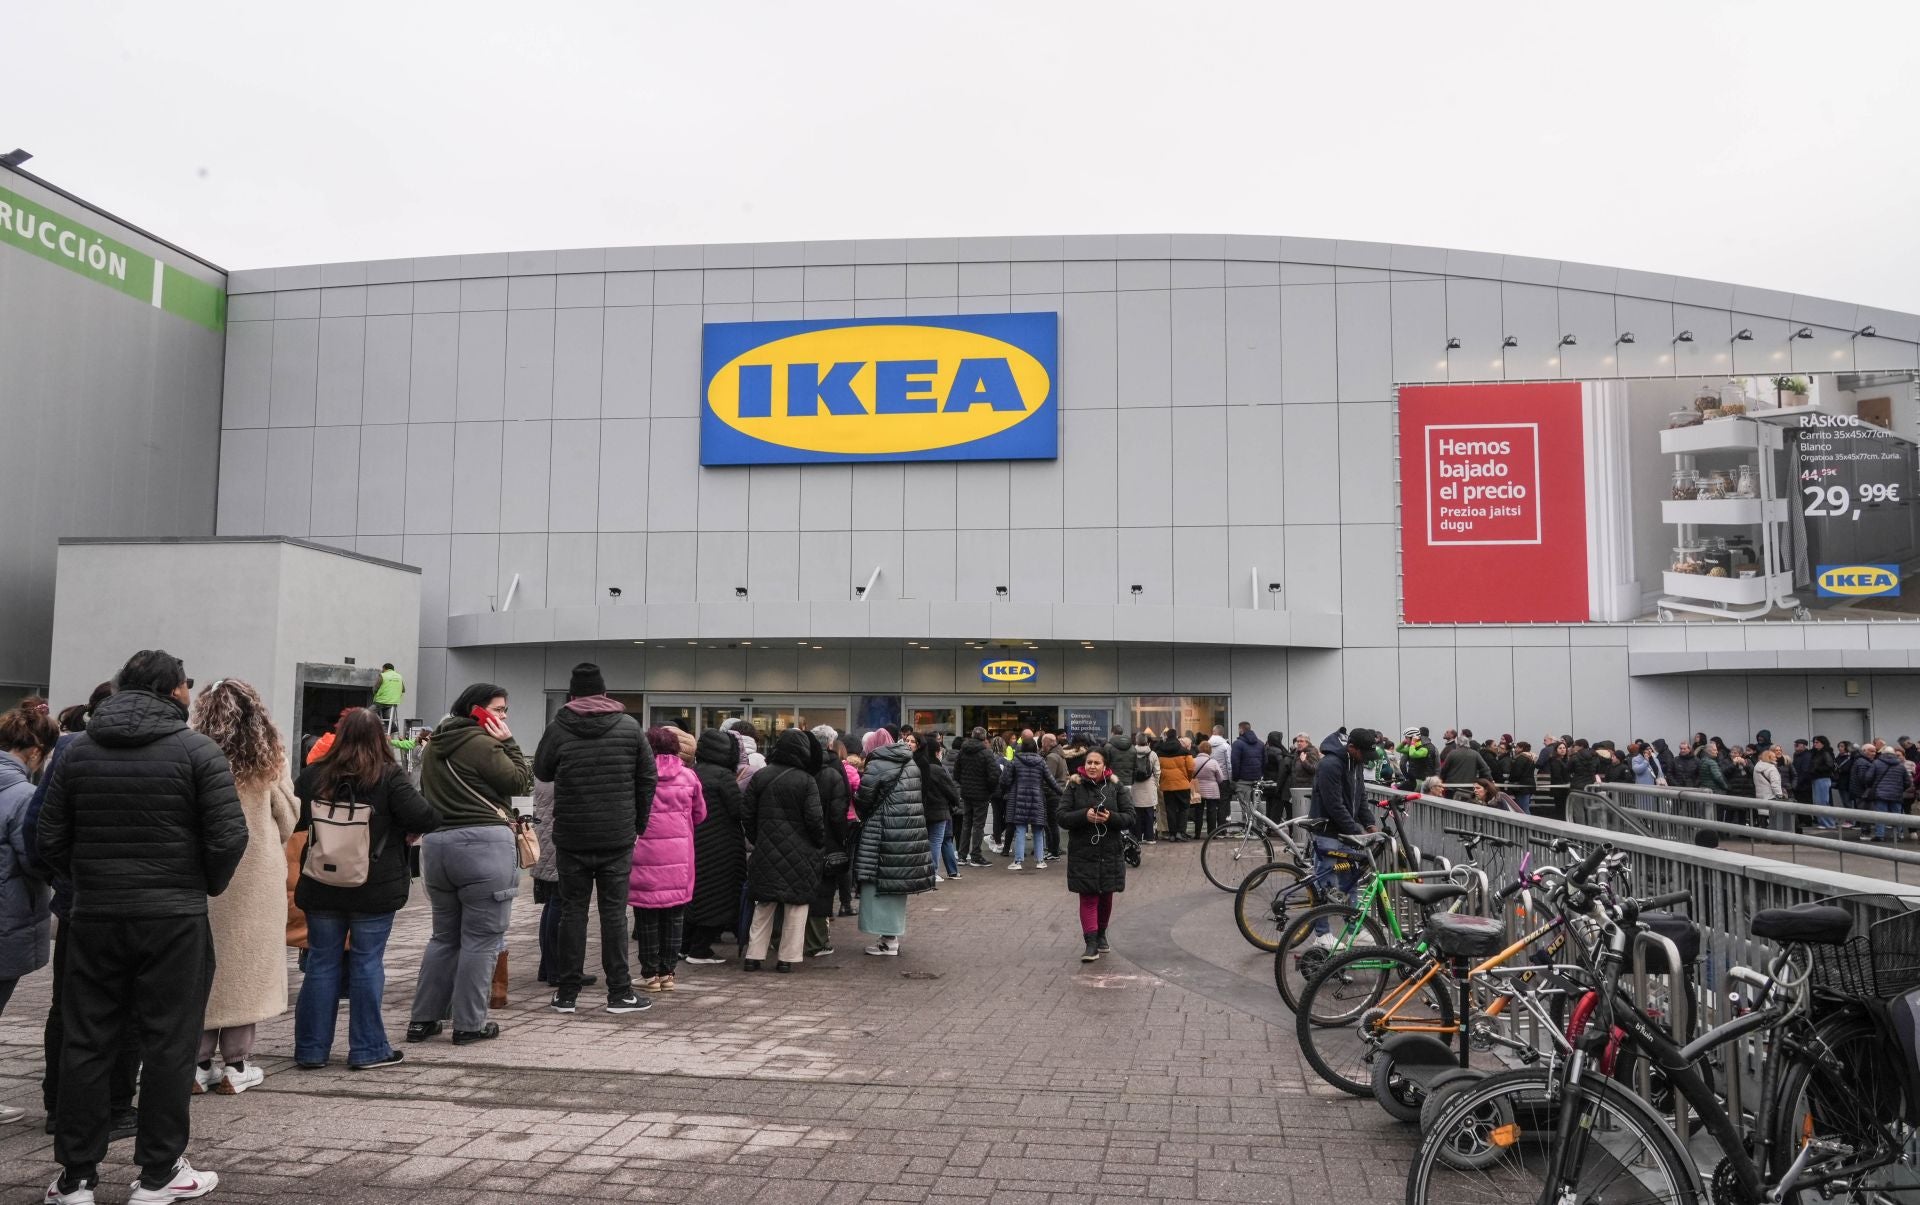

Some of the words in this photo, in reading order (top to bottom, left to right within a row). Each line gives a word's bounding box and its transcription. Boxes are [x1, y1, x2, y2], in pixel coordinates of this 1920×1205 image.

[0, 201, 126, 281] RUCCIÓN
[738, 357, 1028, 418] IKEA
[1800, 413, 1859, 427] RÅSKOG
[1800, 431, 1832, 440] Carrito
[1439, 438, 1511, 456] Hemos
[1800, 442, 1832, 451] Blanco
[1439, 459, 1508, 482] bajado
[1440, 482, 1458, 500] el
[1463, 480, 1526, 505] precio
[1440, 506, 1487, 517] Prezioa
[1488, 505, 1521, 520] jaitsi
[1440, 519, 1473, 533] dugu
[1825, 574, 1893, 587] IKEA
[987, 666, 1031, 675] IKEA
